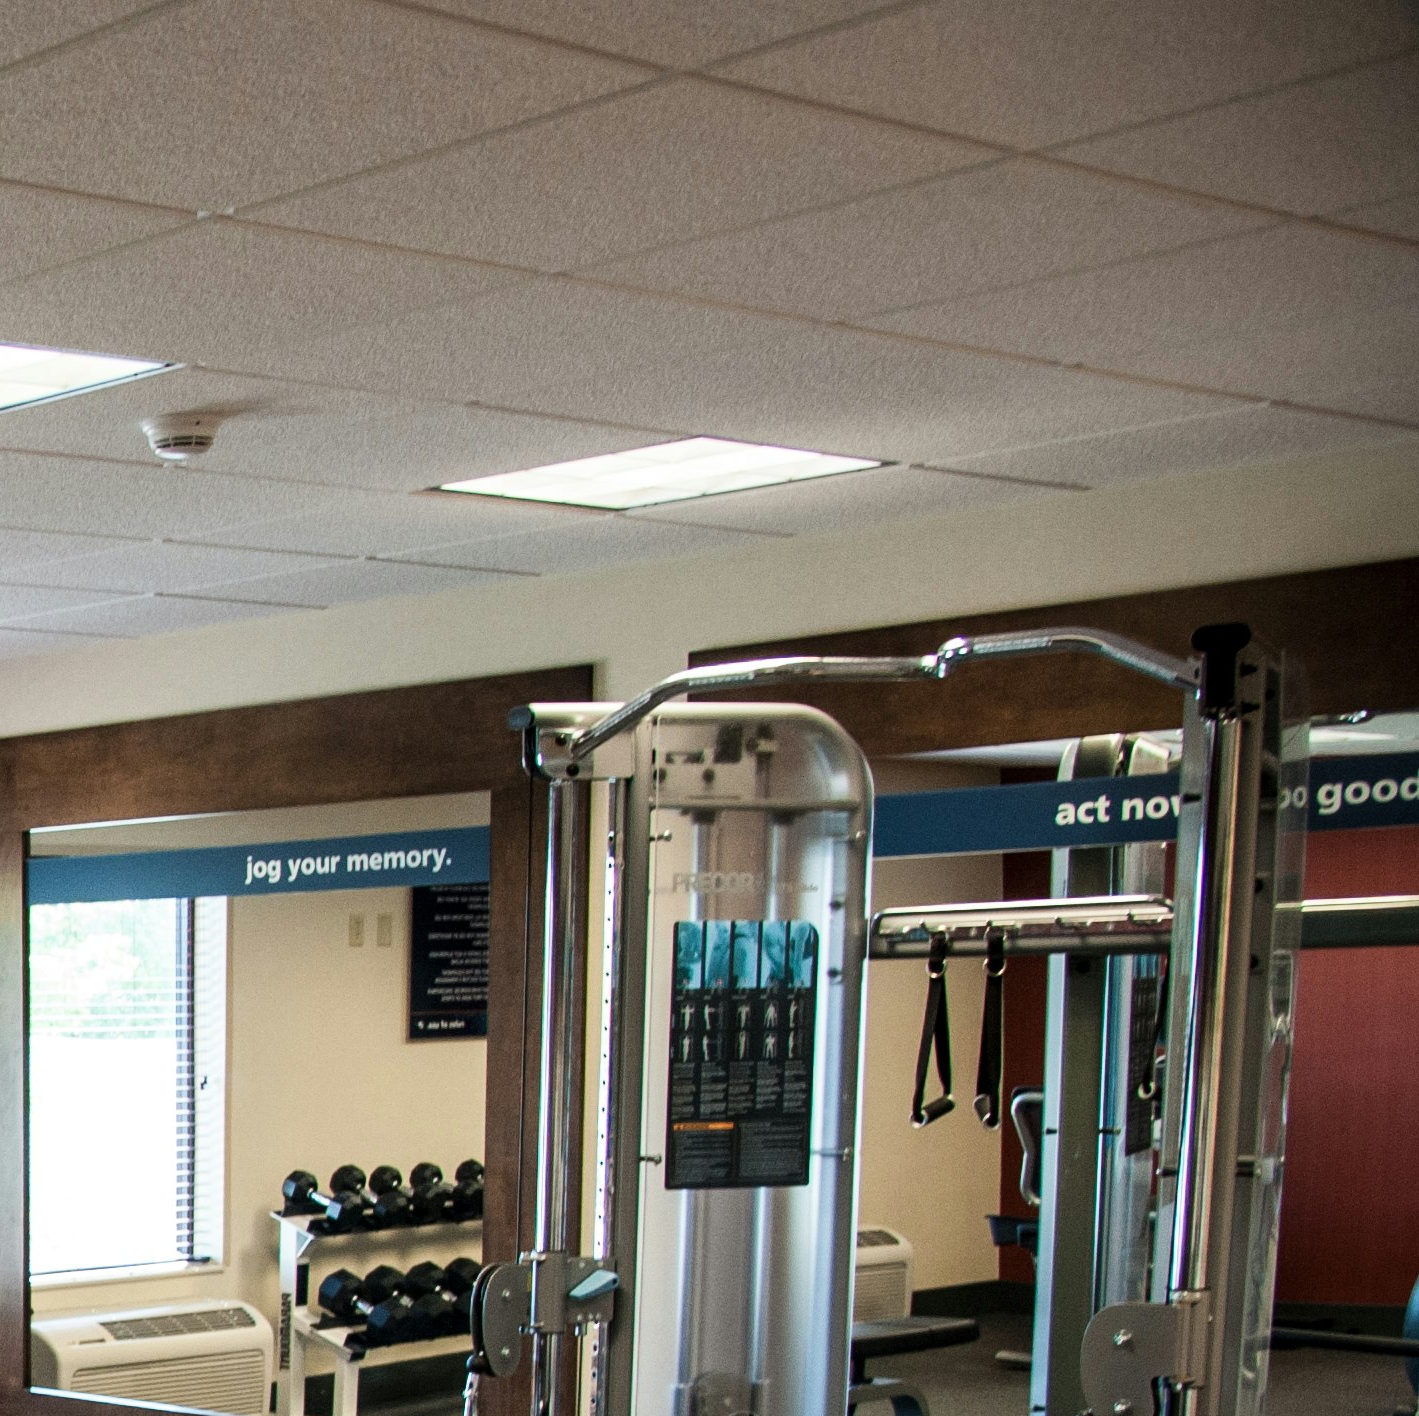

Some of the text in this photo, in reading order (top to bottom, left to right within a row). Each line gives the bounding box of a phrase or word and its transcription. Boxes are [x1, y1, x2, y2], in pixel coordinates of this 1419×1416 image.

[1055, 794, 1110, 826] act
[1316, 769, 1419, 816] good
[245, 847, 452, 885] jog your memory.
